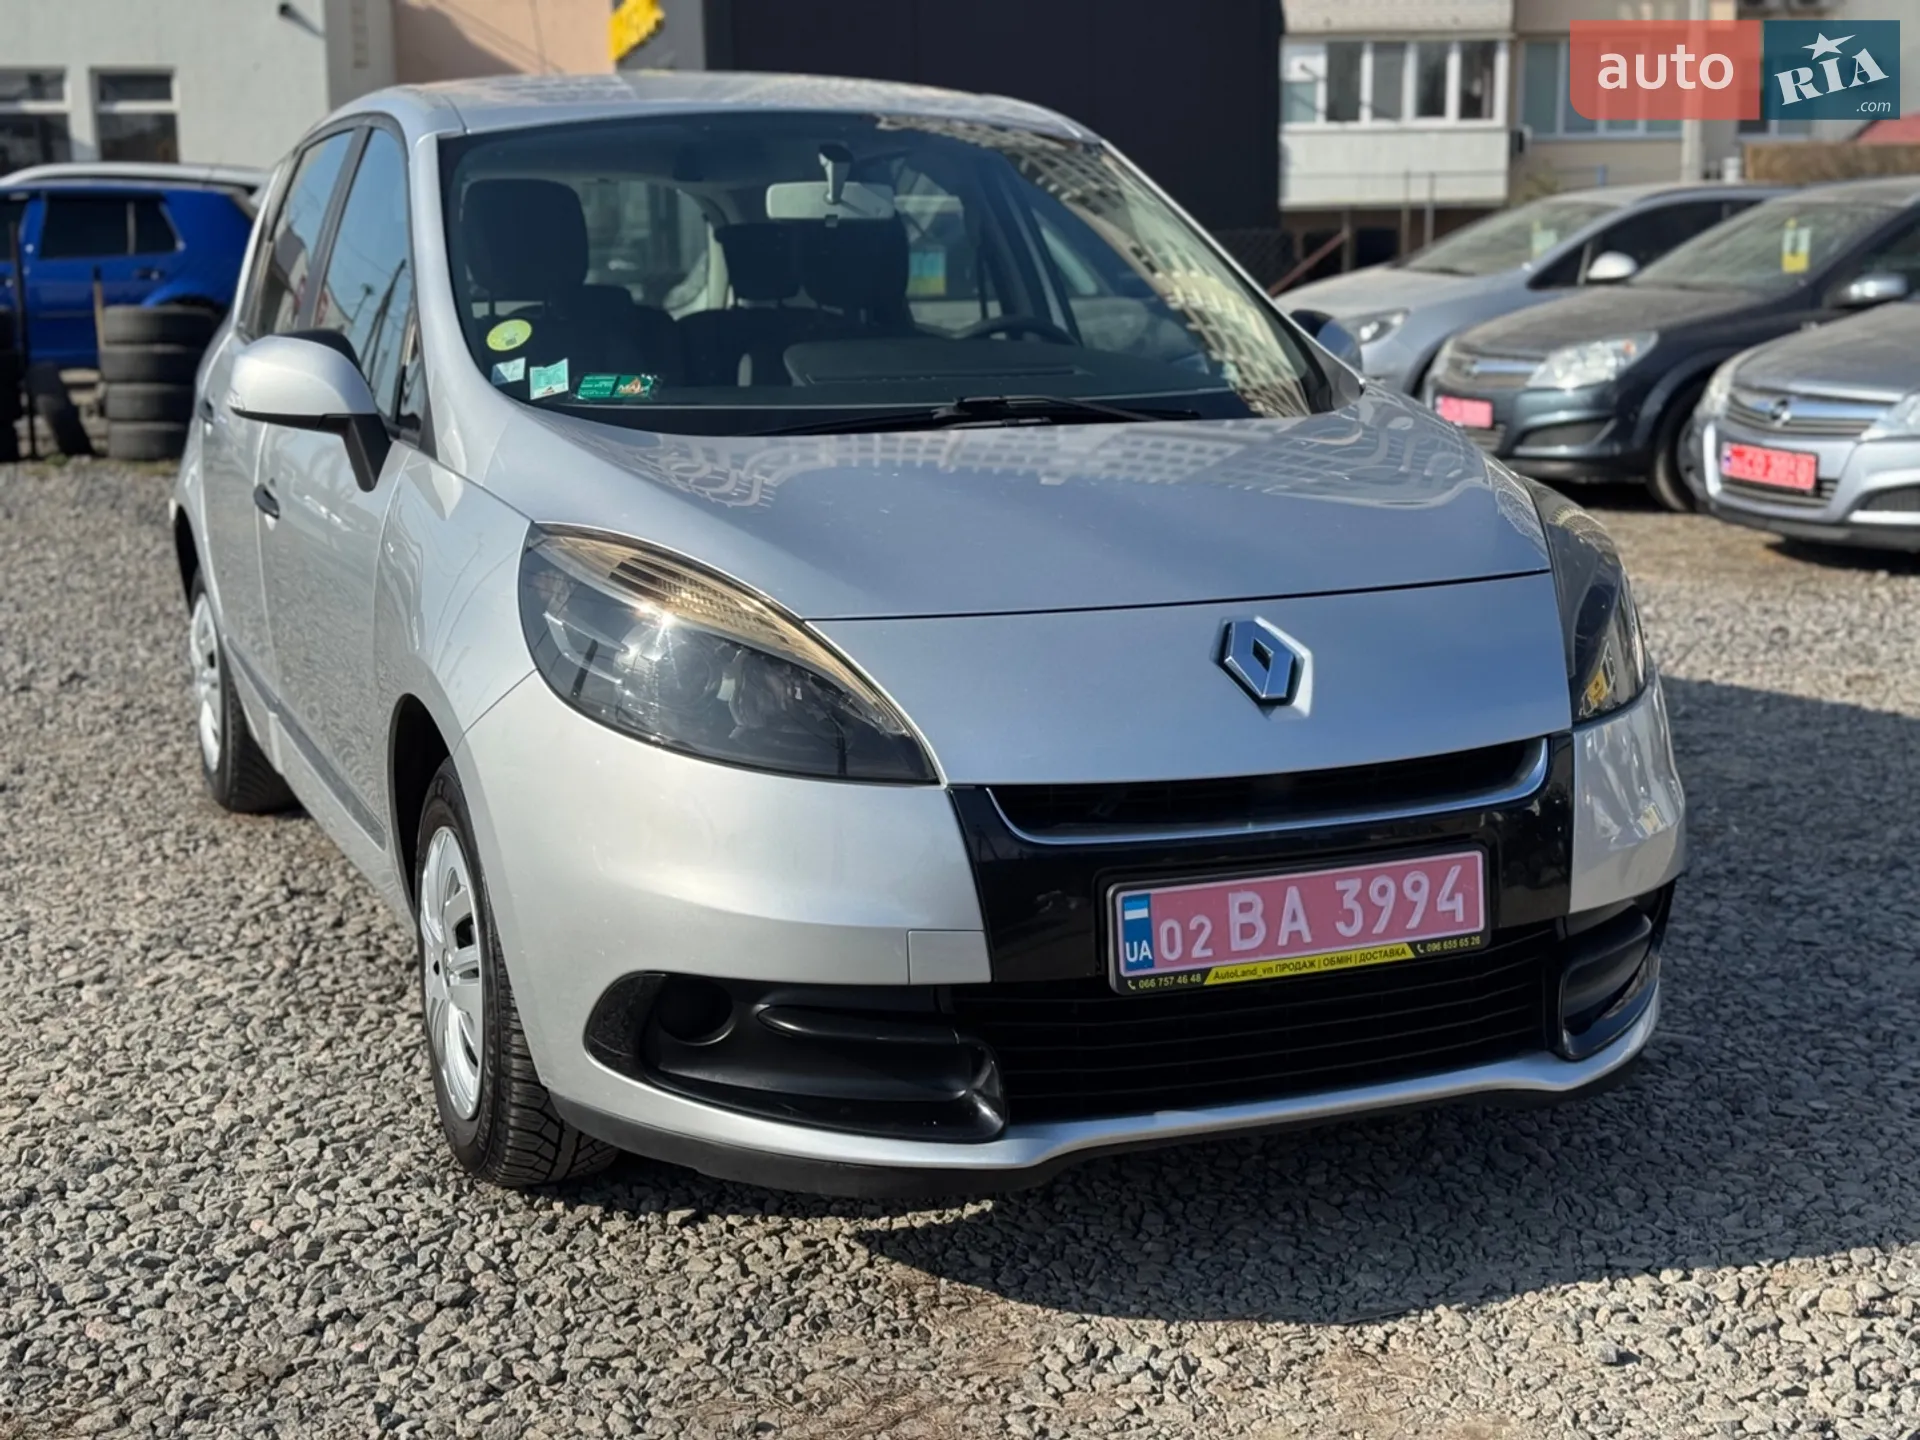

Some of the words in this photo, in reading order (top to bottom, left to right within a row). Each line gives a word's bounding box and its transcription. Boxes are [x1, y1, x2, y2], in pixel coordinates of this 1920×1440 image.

[1159, 914, 1214, 962] 02
[1228, 885, 1313, 952] BA
[1335, 864, 1464, 938] 3994
[1125, 940, 1153, 963] UA
[1275, 959, 1316, 973] ПРОДАЖ
[1322, 955, 1353, 967] ОБМІН
[1359, 947, 1407, 962] ДОСТАВКА
[1158, 976, 1175, 987] 757
[1190, 973, 1202, 983] 48
